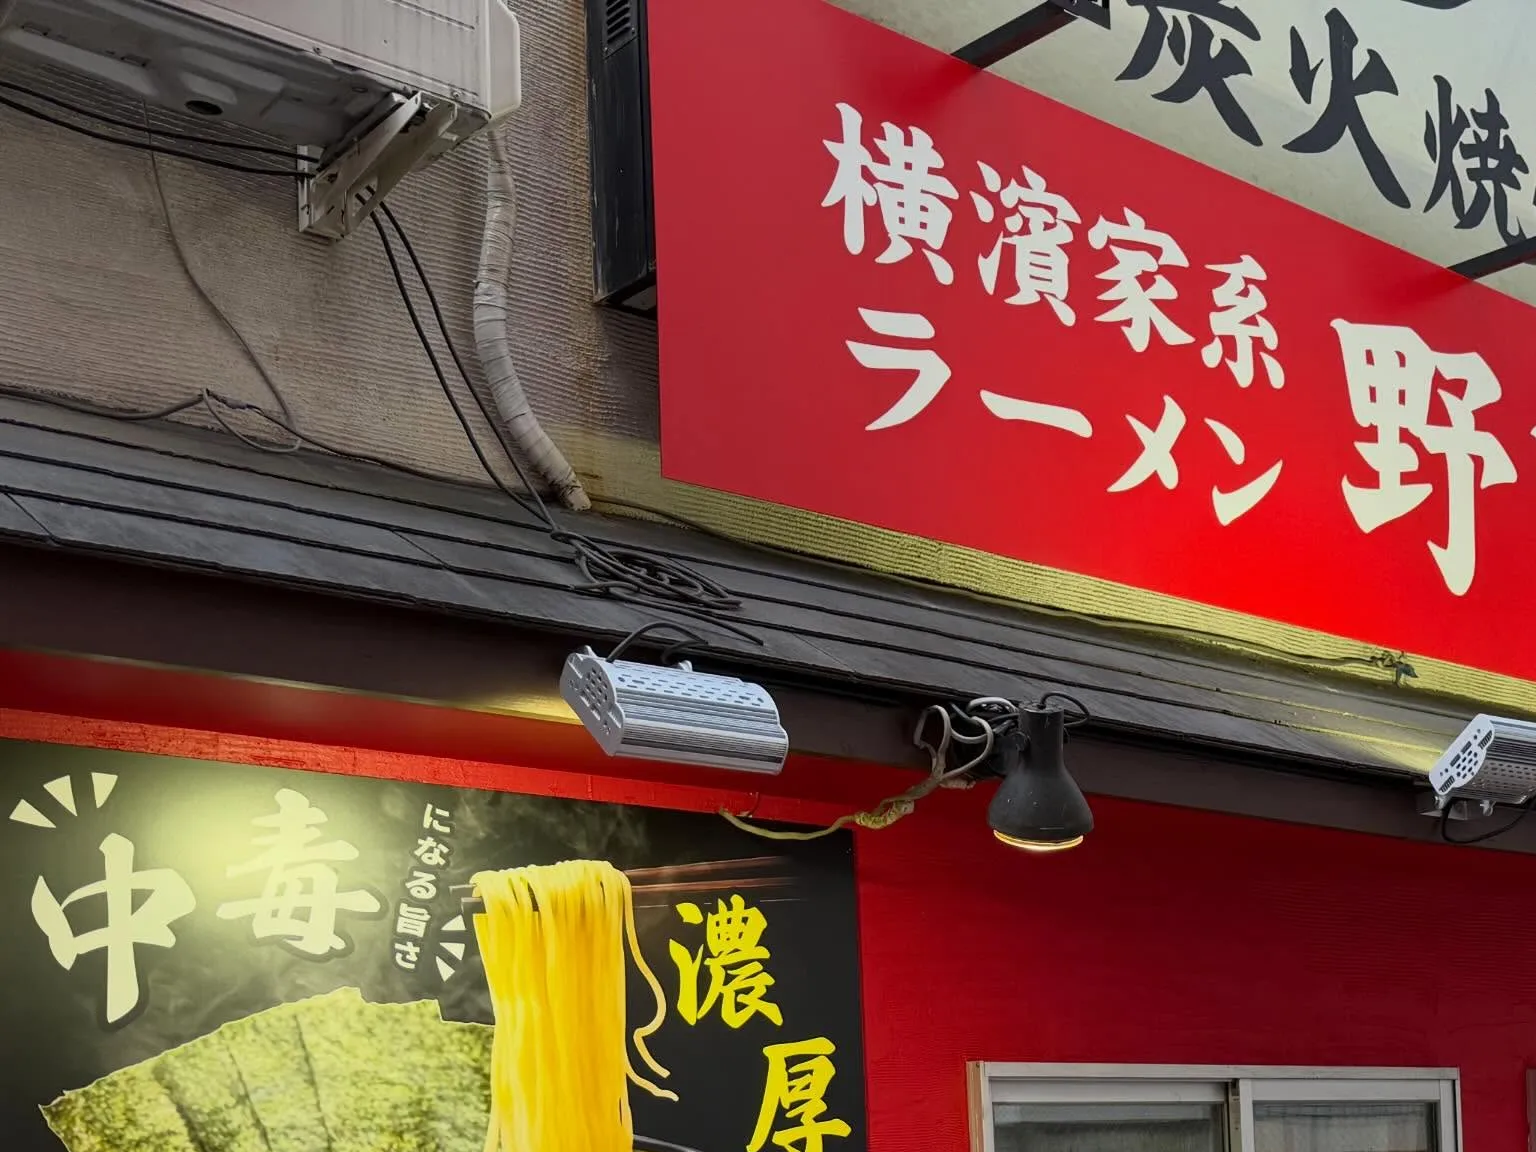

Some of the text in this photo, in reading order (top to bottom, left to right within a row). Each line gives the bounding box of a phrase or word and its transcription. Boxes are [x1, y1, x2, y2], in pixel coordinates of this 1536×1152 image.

[822, 102, 1287, 390] 横濱家系
[845, 306, 1284, 526] ラーメン
[30, 787, 384, 1024] 中毒
[393, 802, 453, 970] になる旨さ
